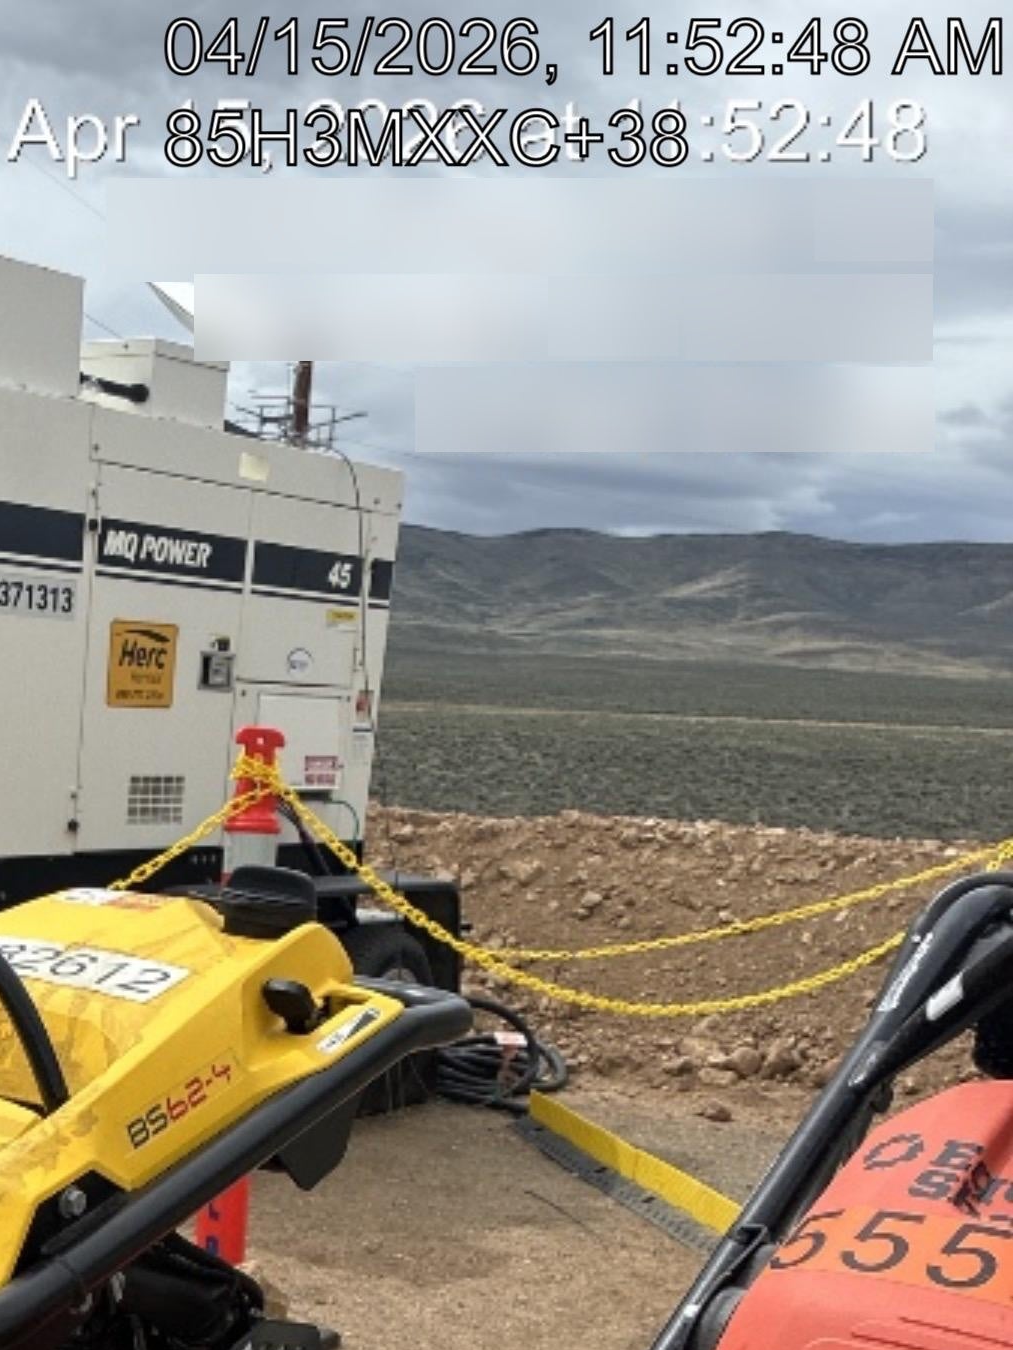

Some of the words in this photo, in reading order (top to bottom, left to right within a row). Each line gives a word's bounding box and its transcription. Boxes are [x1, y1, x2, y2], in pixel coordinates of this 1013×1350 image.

[103, 530, 138, 563] MQ
[139, 534, 213, 568] POWER
[328, 560, 354, 590] 45
[118, 639, 168, 669] Herc
[126, 1063, 231, 1149] BS62-4
[769, 1208, 1013, 1289] 555
